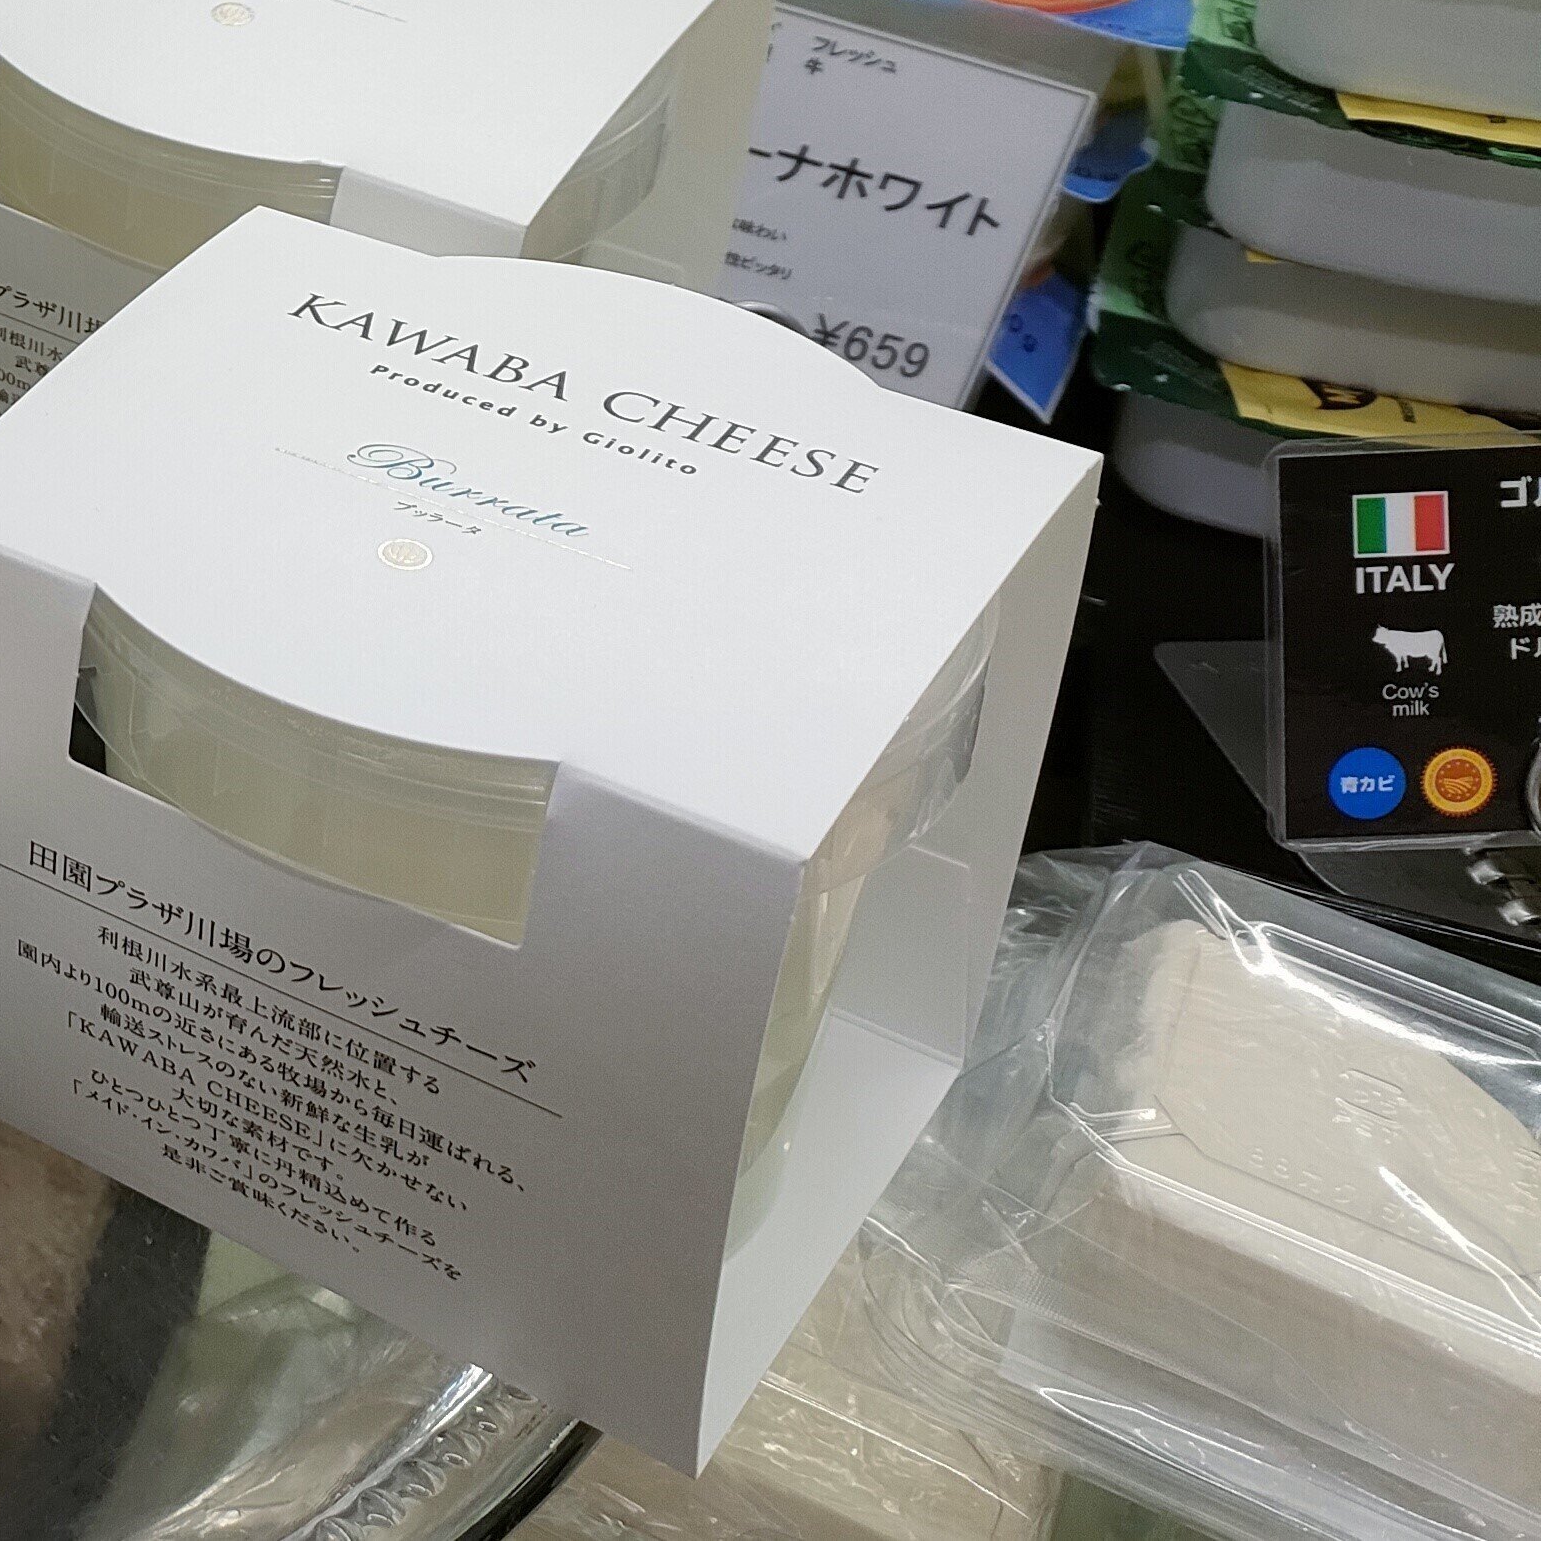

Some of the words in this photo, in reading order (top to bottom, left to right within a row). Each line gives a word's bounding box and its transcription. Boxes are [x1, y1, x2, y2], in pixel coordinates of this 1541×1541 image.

[812, 36, 897, 75] フレッシュ
[287, 292, 570, 403] KAWABA
[602, 389, 881, 495] CHEESE
[813, 313, 930, 379] ¥659
[369, 363, 519, 419] Produced
[529, 413, 569, 435] by
[582, 430, 698, 476] Giolito
[346, 442, 591, 539] Burrata
[394, 500, 482, 536] ブッラータ
[1356, 562, 1455, 594] ITALY
[1382, 683, 1439, 700] Cow's
[1392, 700, 1430, 717] milk
[1340, 775, 1394, 794] 青カビ
[28, 839, 536, 1084] 田園プラザ川場のフレッシュチーズ
[98, 925, 442, 1094] 利根川水系最上流部に位置する
[17, 938, 526, 1192] 園内より100mの近さにある牧場から毎日運ばれる、
[99, 1002, 432, 1167] 輸送ストレスのない新鮮な生乳が
[129, 966, 397, 1106] 武尊山が育んだ天然水と、
[67, 1010, 196, 1085] 「KAWABA
[206, 1080, 468, 1211] CHEESE」に欠かせない
[90, 1069, 437, 1247] ひとつひとつ丁寧に丹精込めて作る
[170, 1086, 344, 1180] 大切な素材です。
[72, 1079, 462, 1281] 「メイド・イン・カワバ」のフレッシュチーズを
[161, 1144, 360, 1253] 是非ご賞味ください。
